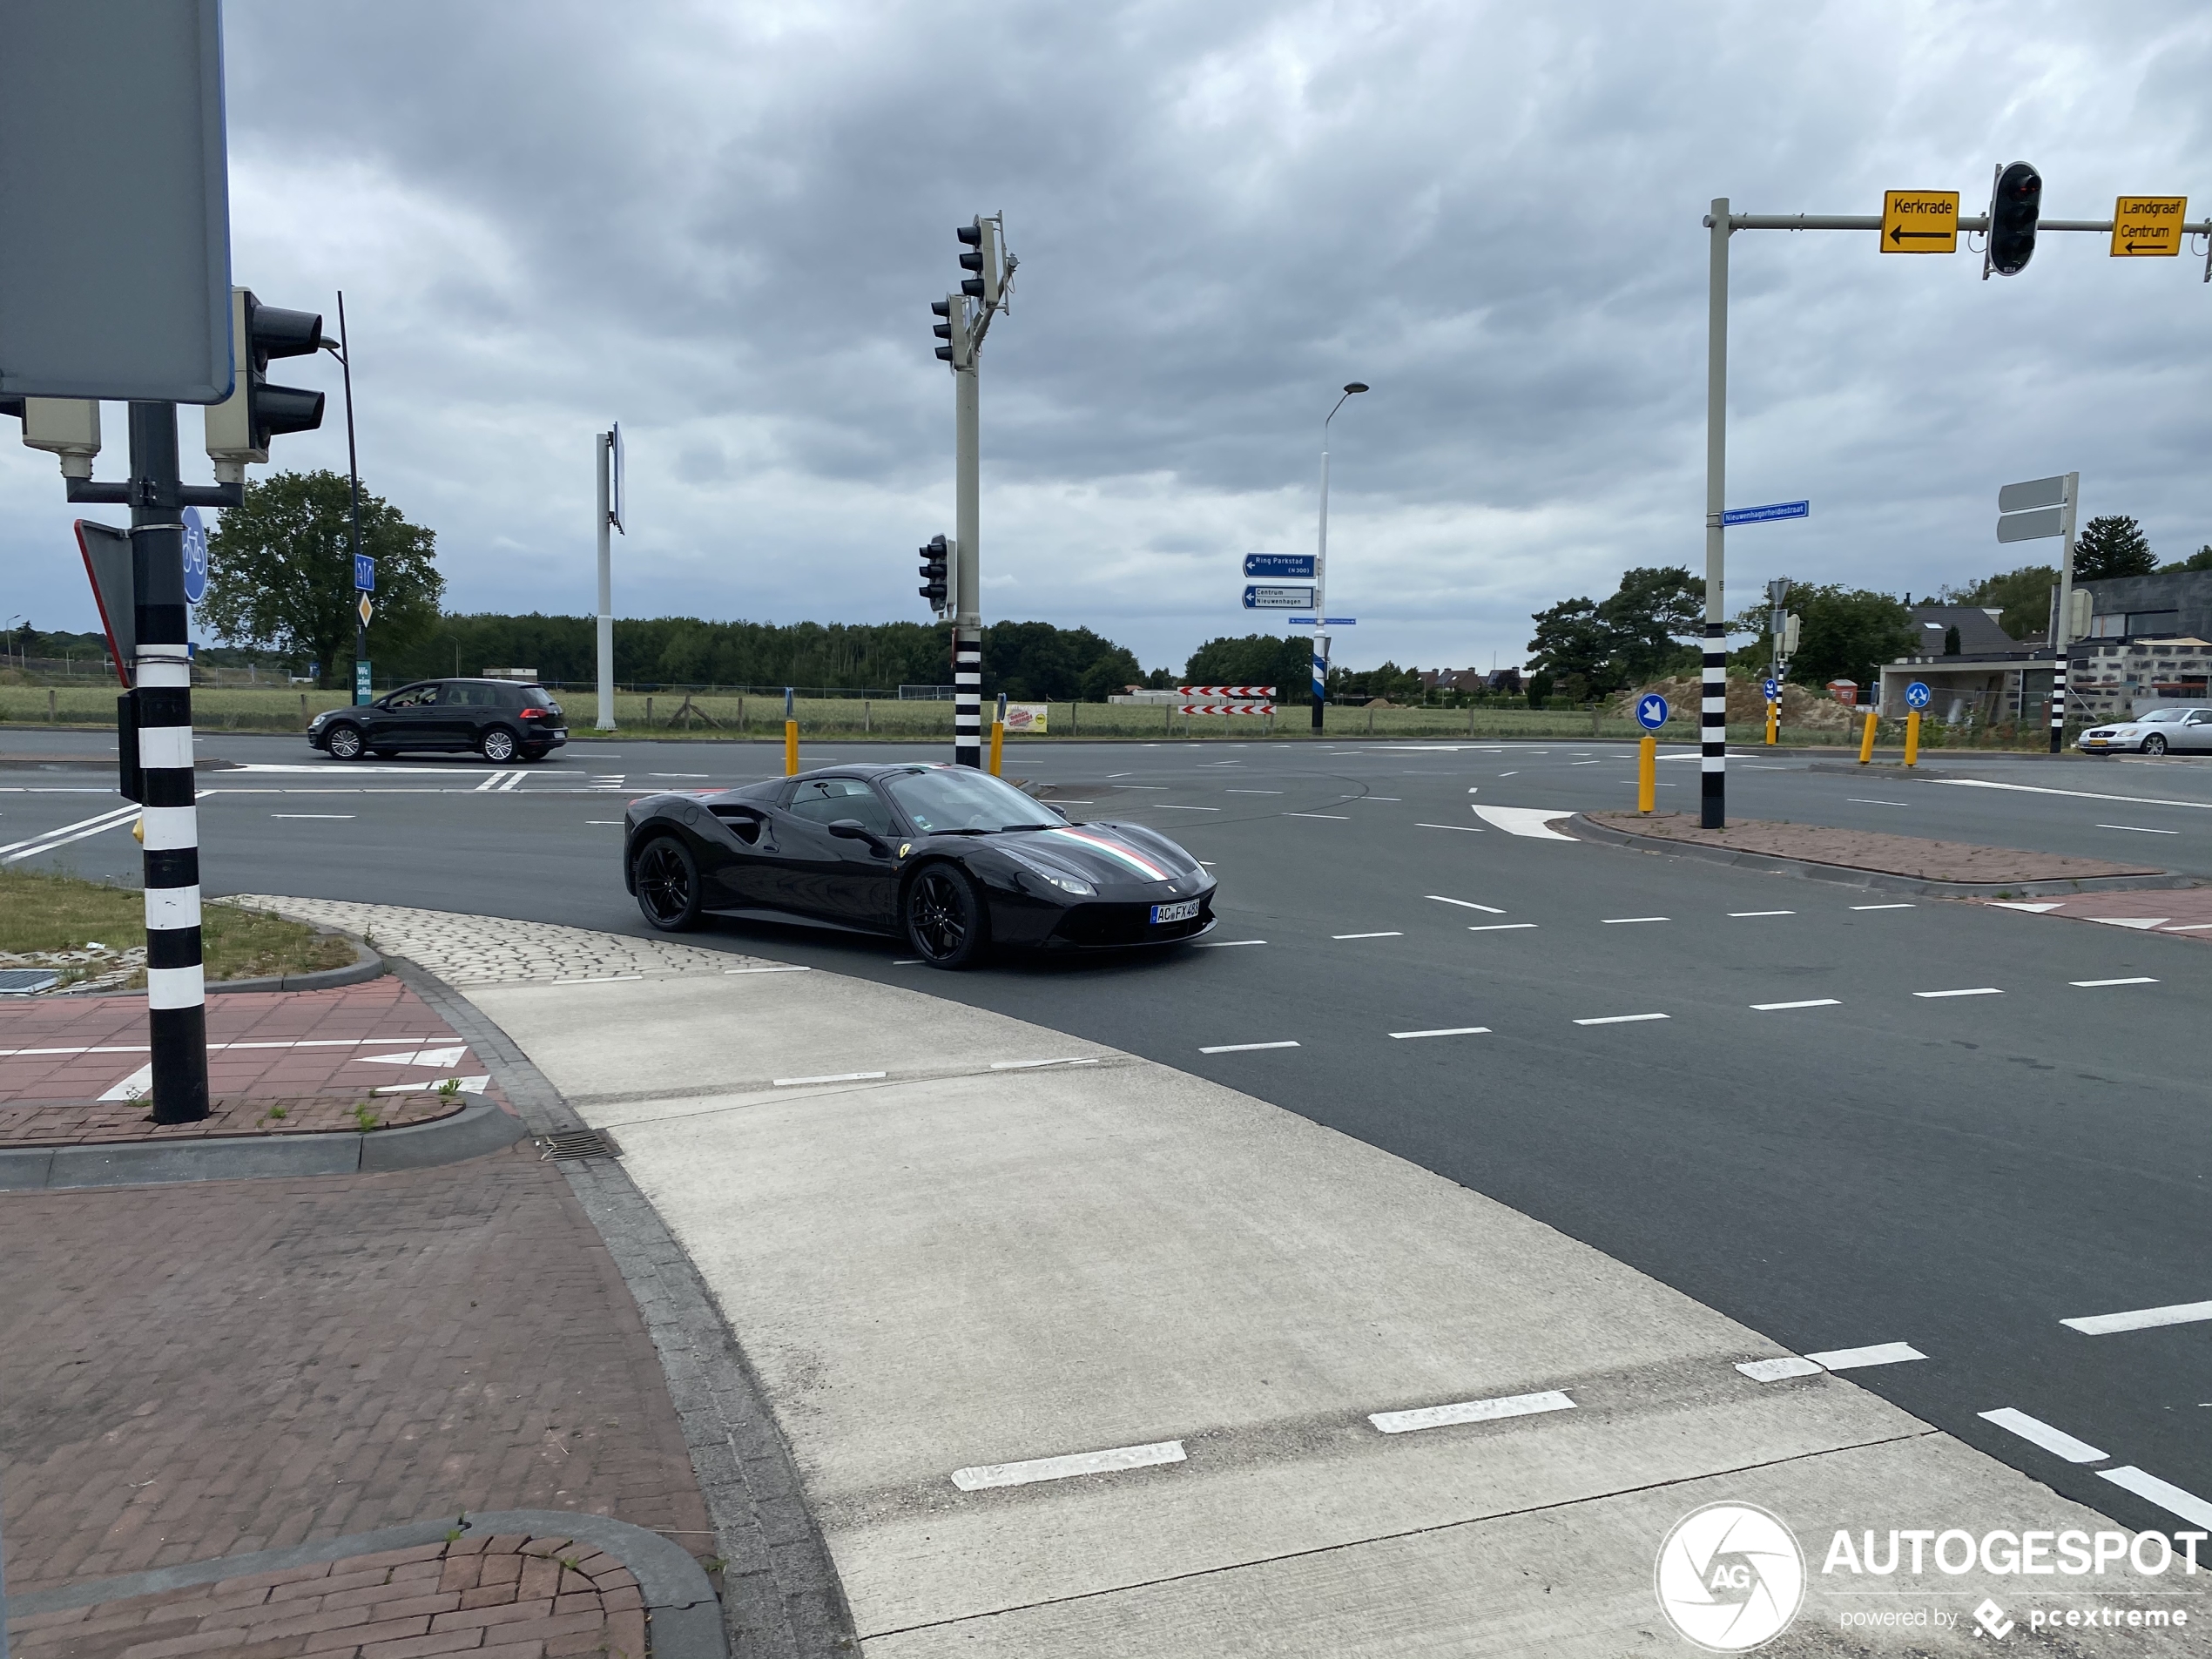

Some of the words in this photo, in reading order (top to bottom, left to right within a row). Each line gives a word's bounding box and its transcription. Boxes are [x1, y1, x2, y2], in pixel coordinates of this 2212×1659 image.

[1893, 198, 1953, 215] Kerkrade
[2123, 200, 2181, 217] Landgraaf
[2121, 225, 2169, 238] Centrum
[1157, 907, 1171, 921] AC
[1175, 905, 1187, 920] FX
